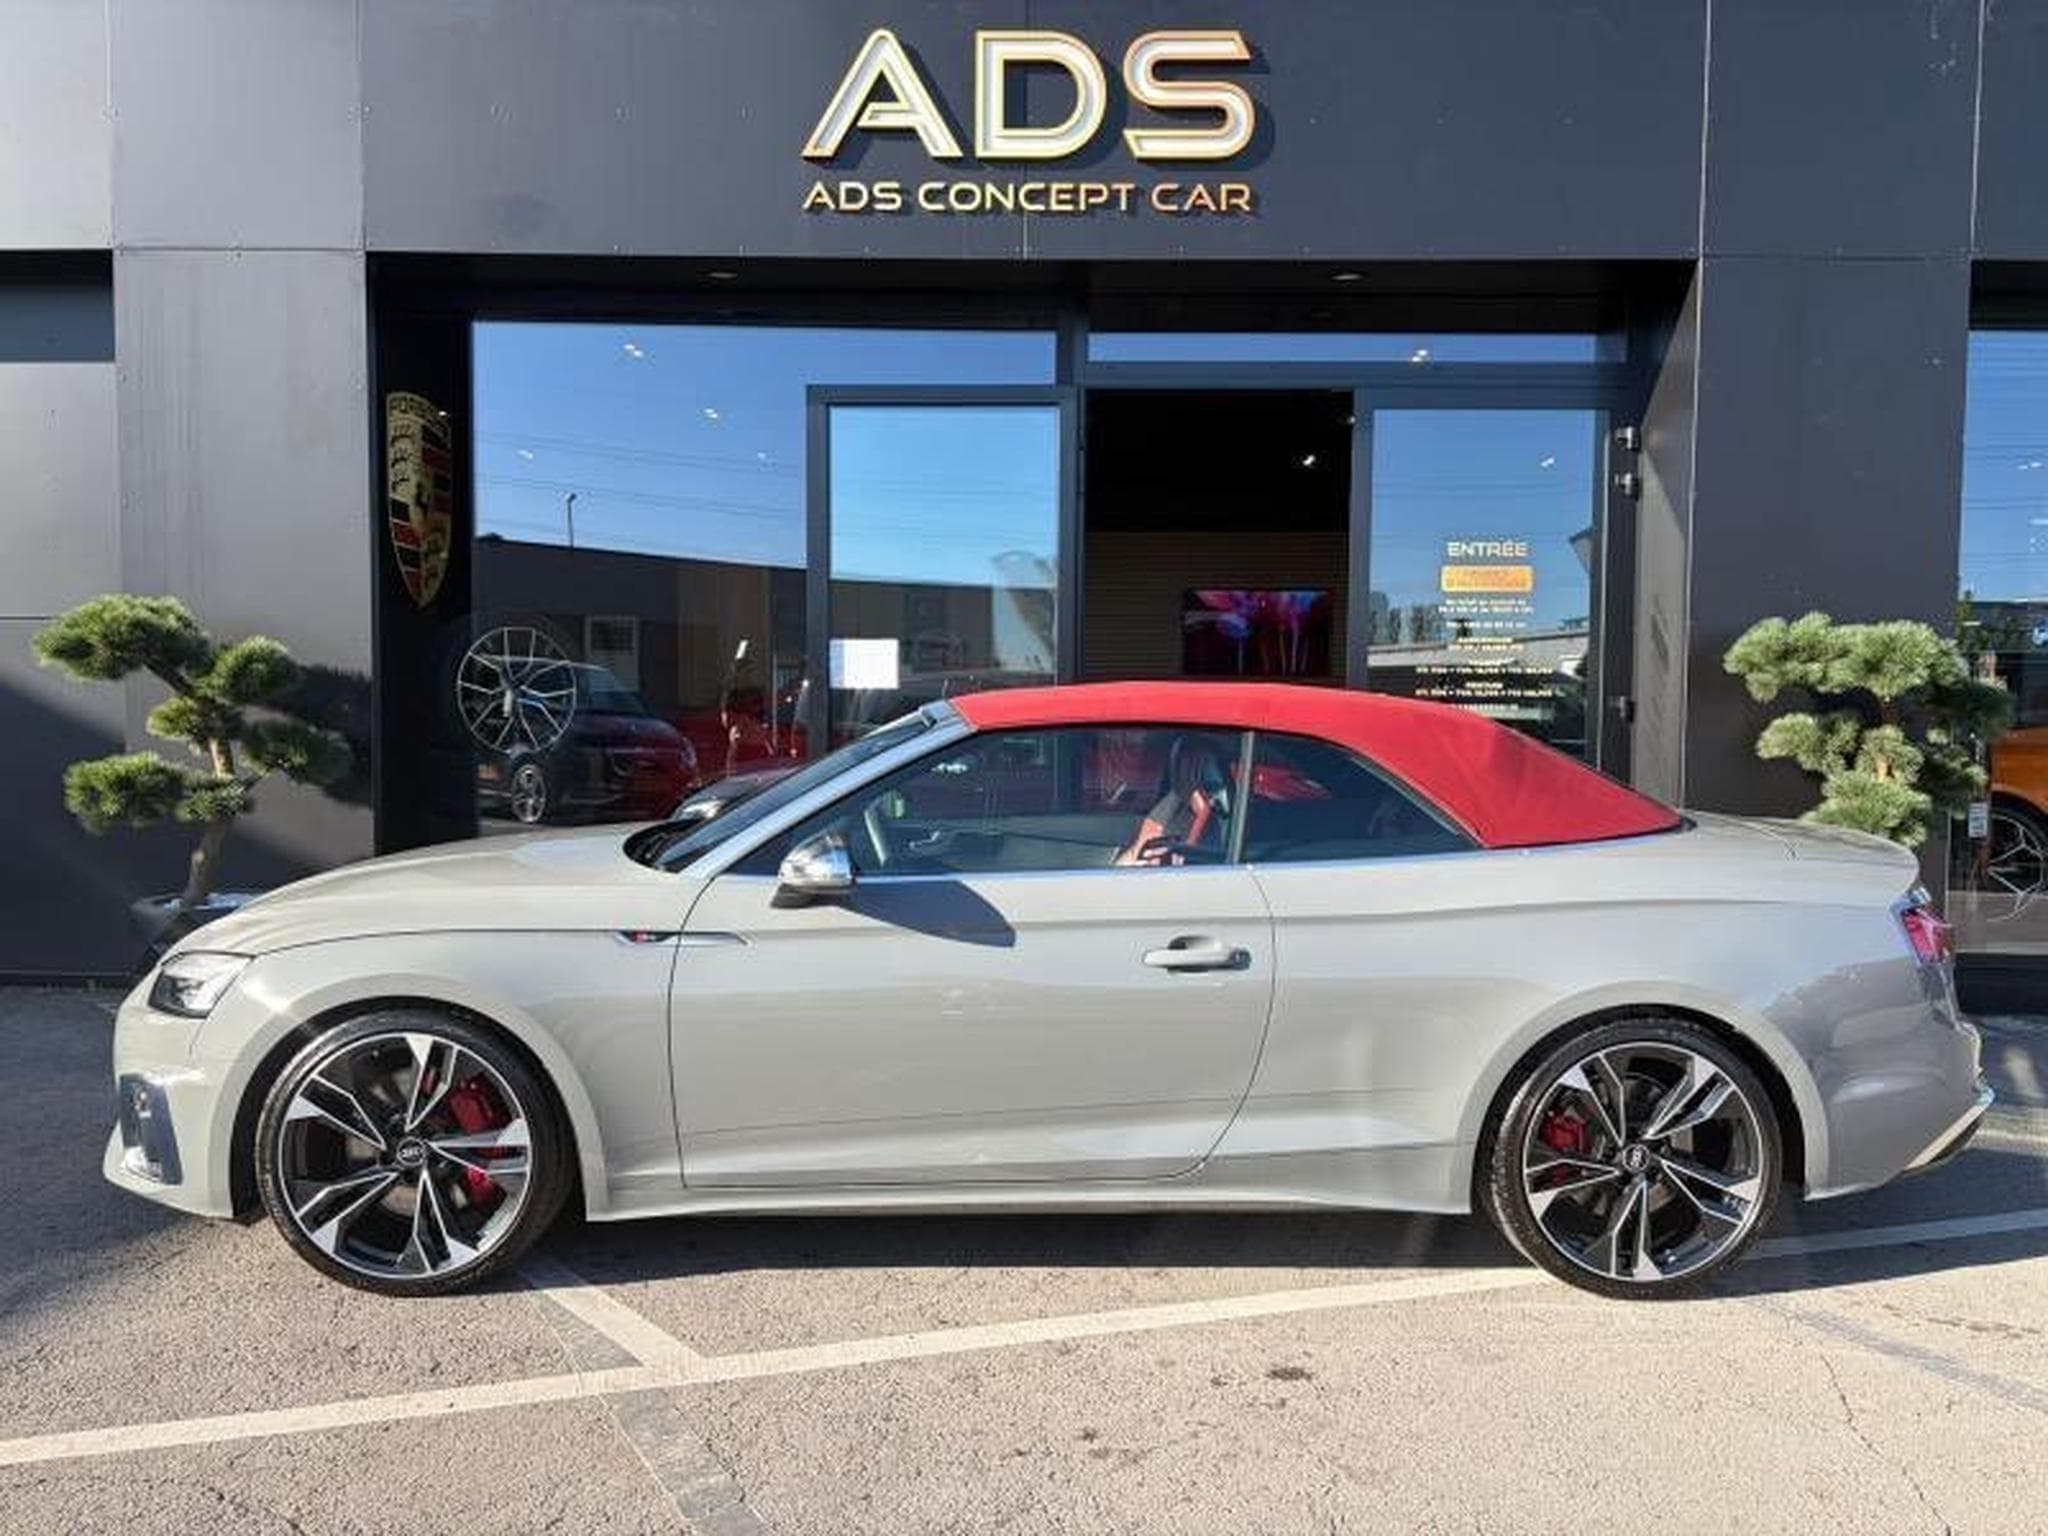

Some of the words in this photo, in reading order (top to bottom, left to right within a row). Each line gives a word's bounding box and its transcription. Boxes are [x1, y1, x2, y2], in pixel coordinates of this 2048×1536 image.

[800, 28, 1256, 159] ADS
[802, 181, 902, 212] ADS
[917, 181, 1136, 212] CONCEPT
[1150, 182, 1252, 212] CAR
